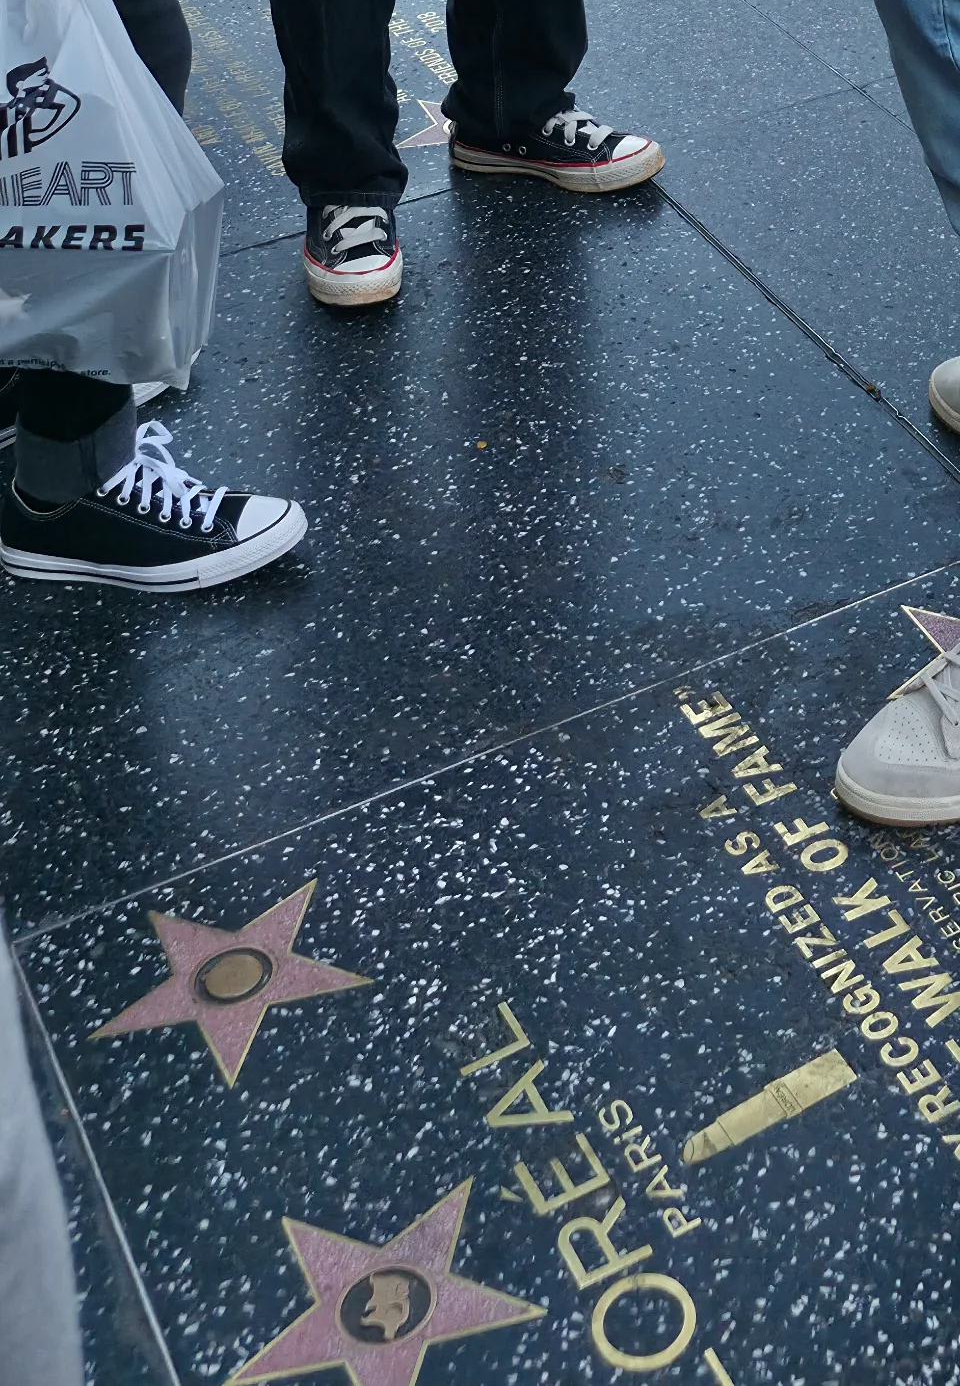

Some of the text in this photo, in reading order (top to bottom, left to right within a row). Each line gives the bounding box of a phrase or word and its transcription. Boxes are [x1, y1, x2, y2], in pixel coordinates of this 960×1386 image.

[699, 794, 737, 819] A
[724, 831, 780, 875] AS
[774, 818, 848, 872] OF
